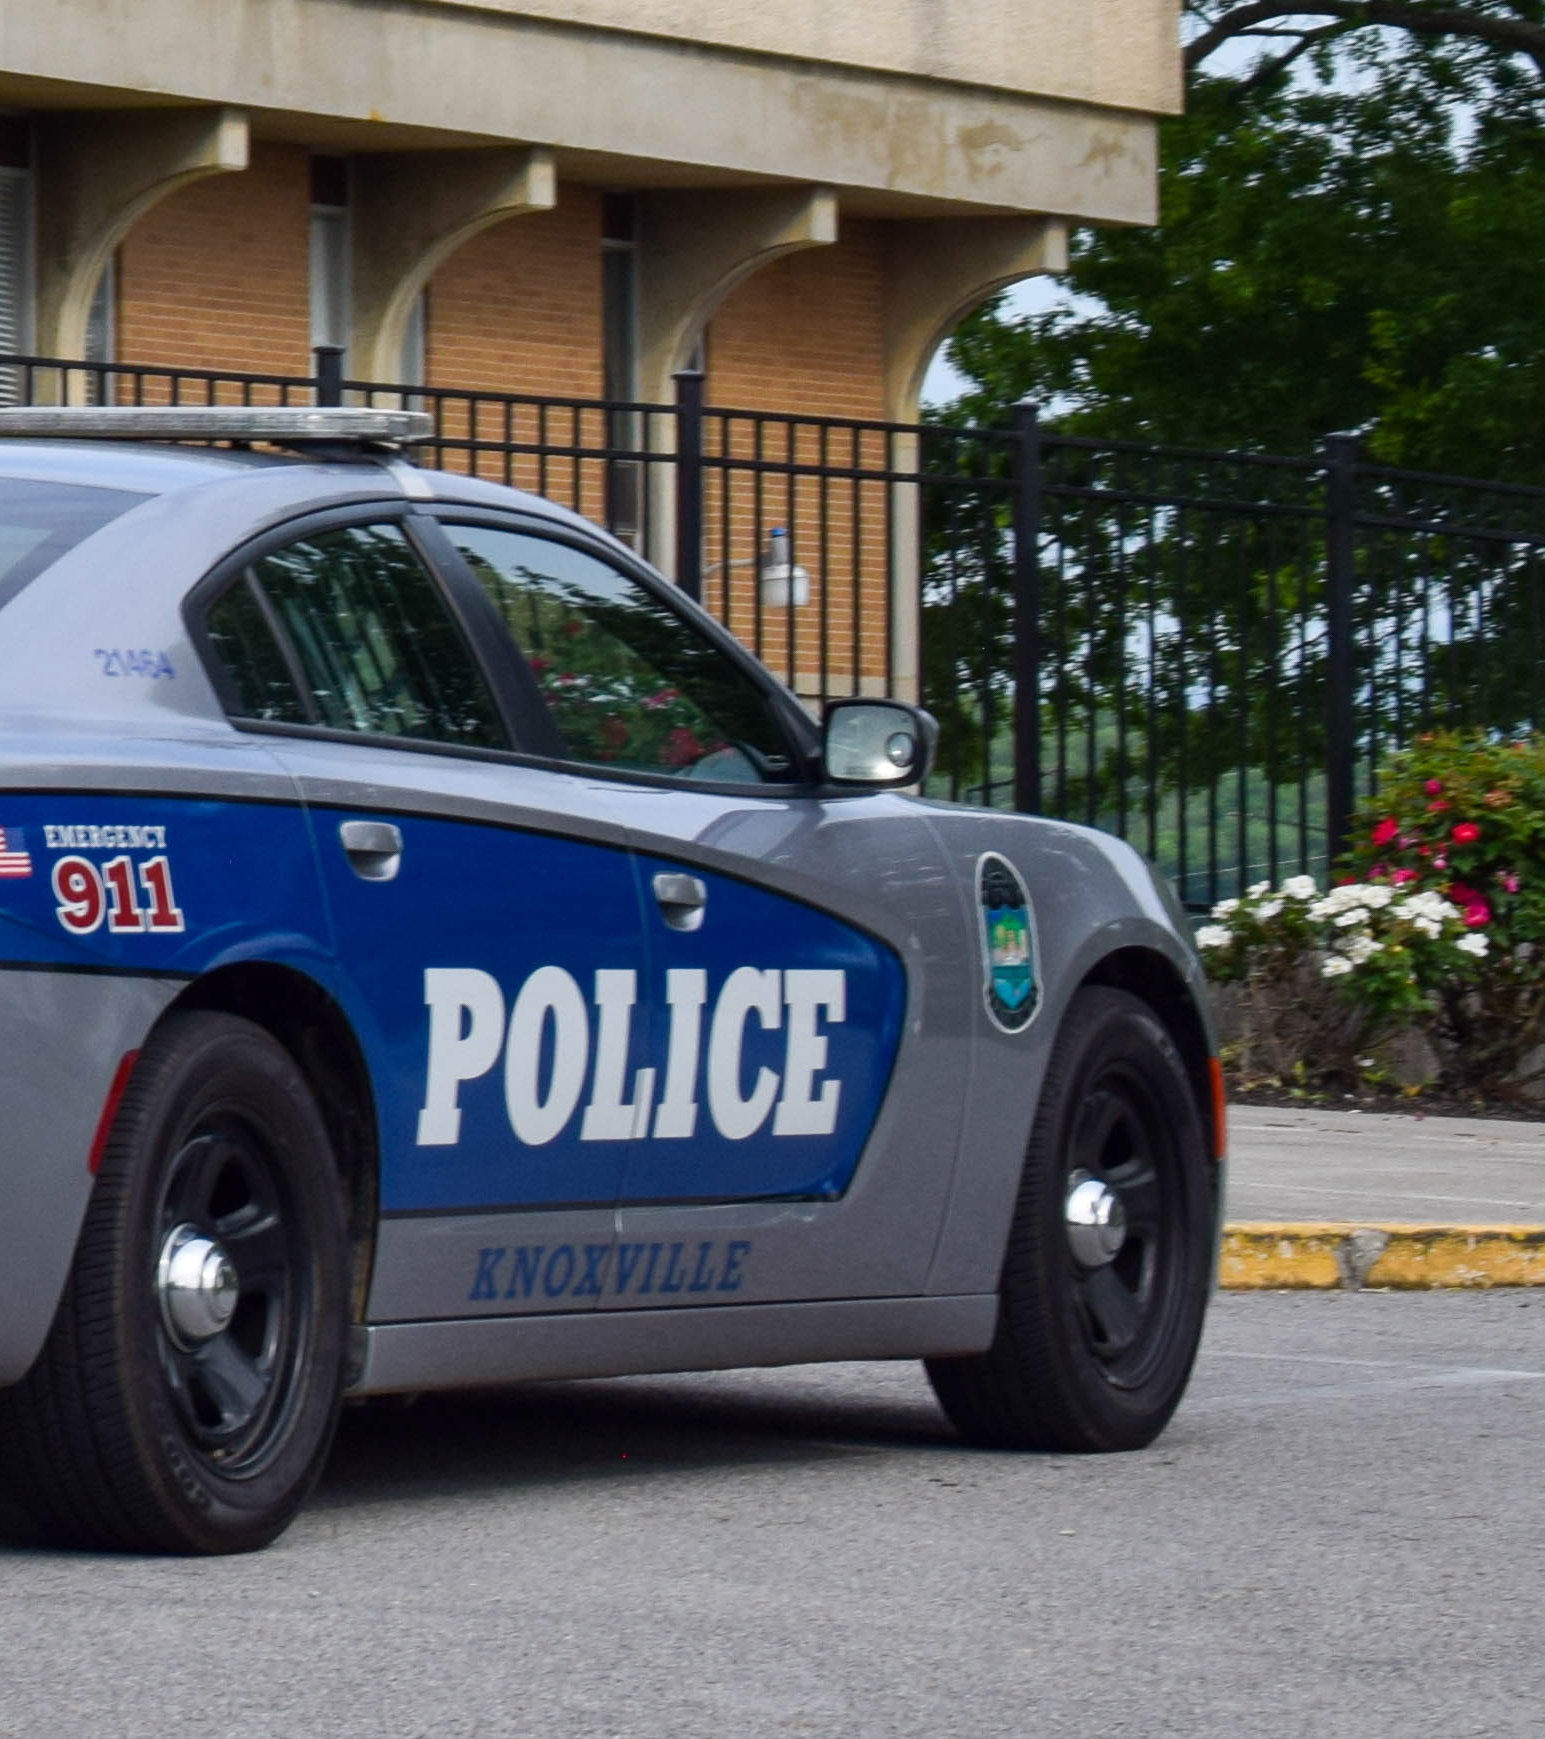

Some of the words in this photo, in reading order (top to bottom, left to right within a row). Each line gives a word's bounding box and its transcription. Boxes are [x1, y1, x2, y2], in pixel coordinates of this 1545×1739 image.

[43, 824, 167, 849] EMERGENCY
[51, 854, 186, 935] 911
[416, 965, 846, 1147] POLICE
[468, 1240, 752, 1301] KNOXVILLE
